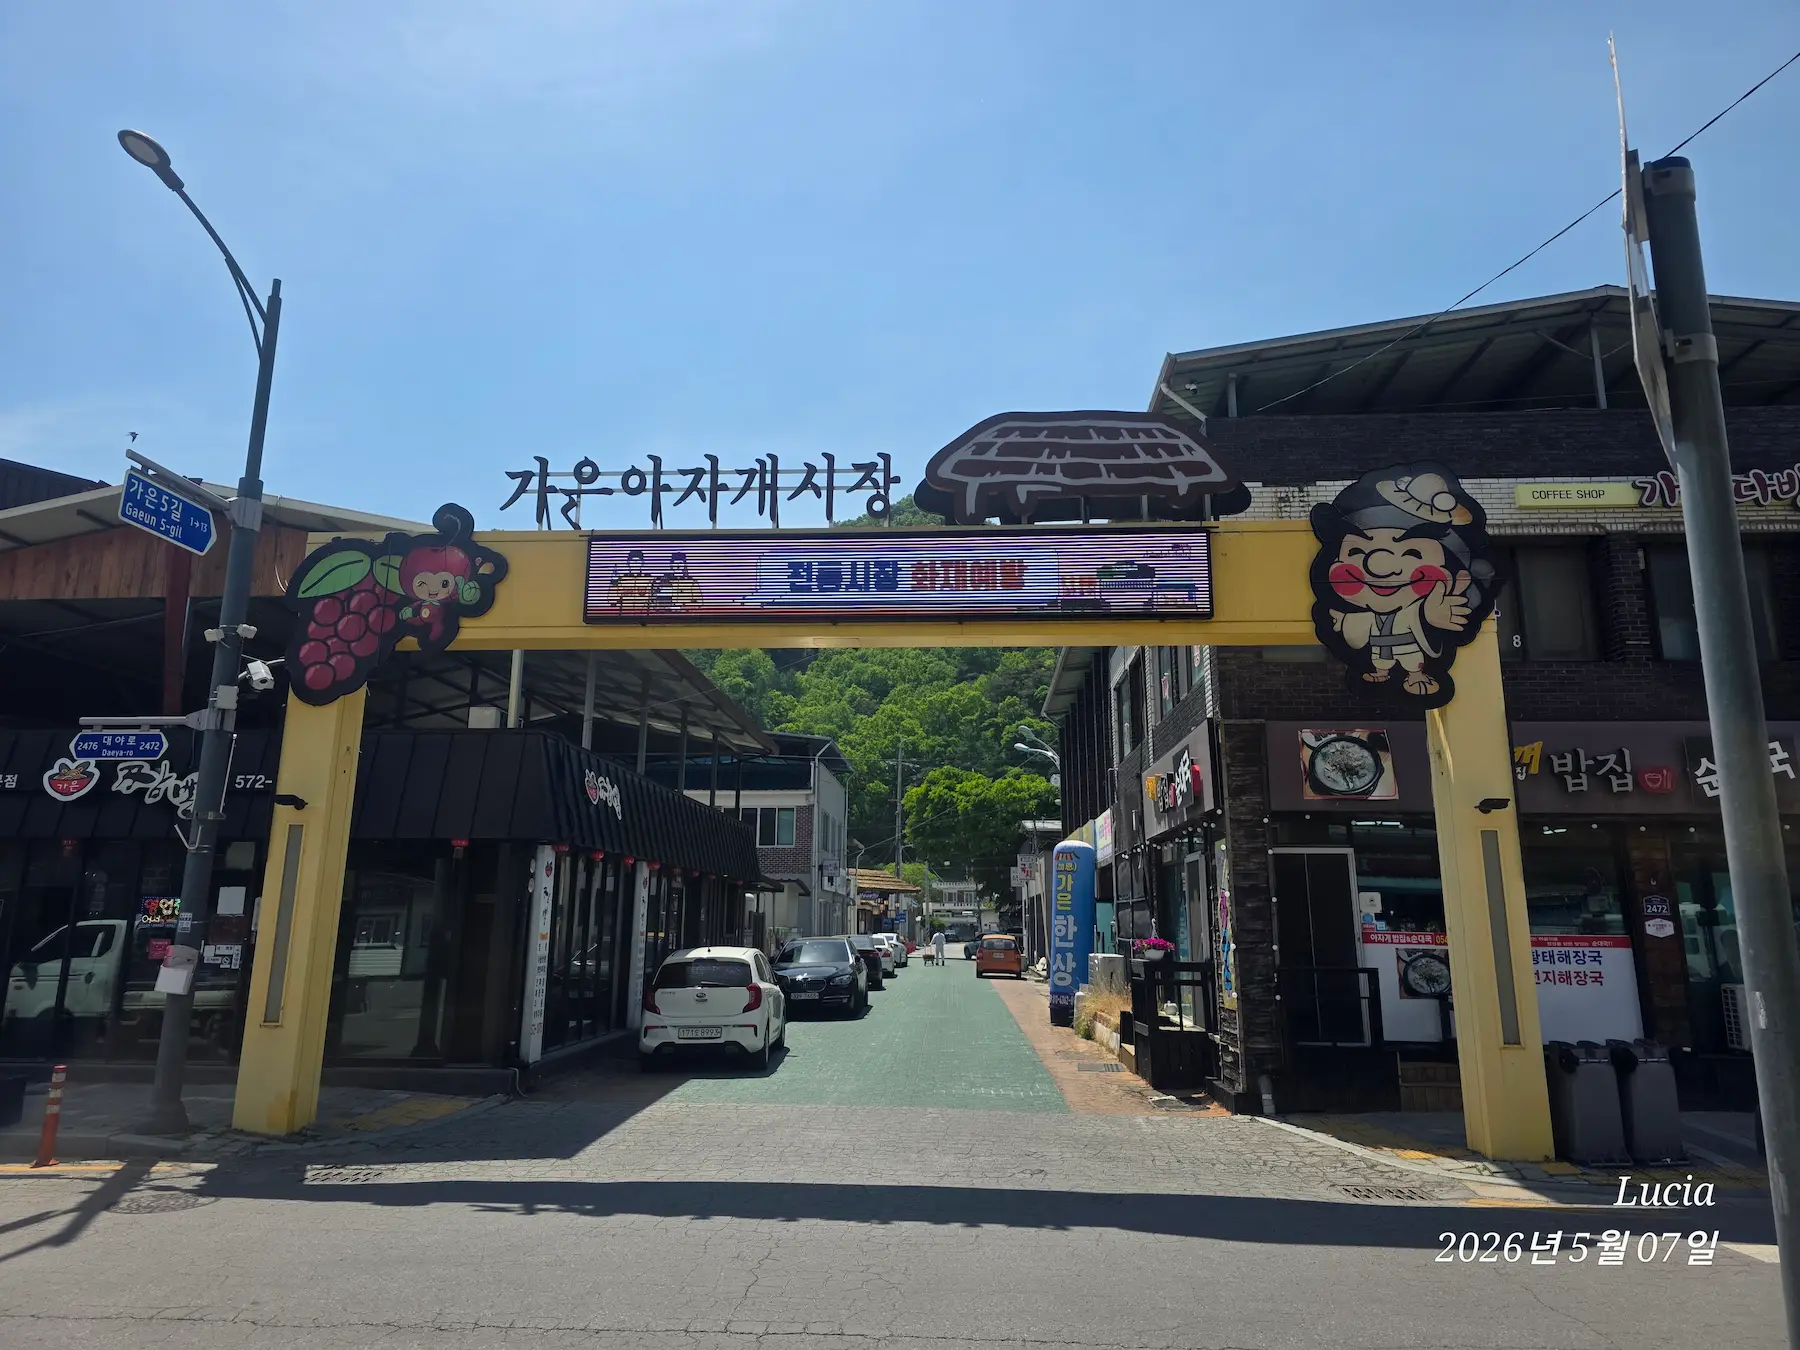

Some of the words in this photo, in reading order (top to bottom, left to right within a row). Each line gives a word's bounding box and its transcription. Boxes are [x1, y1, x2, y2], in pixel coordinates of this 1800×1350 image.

[129, 478, 183, 523] 가은5길
[1531, 489, 1573, 500] COFFEE
[1576, 489, 1606, 499] SHOP
[125, 502, 157, 527] Gaeun
[159, 518, 183, 539] 5-gil
[77, 741, 99, 751] 2476
[139, 741, 160, 751] 2472
[101, 748, 134, 758] Daeya-ro
[1549, 747, 1634, 793] 밥집
[57, 780, 80, 792] 가은
[234, 774, 273, 789] 572-
[1056, 873, 1074, 911] 가은
[1646, 904, 1668, 913] 2472
[1053, 914, 1078, 987] 한상
